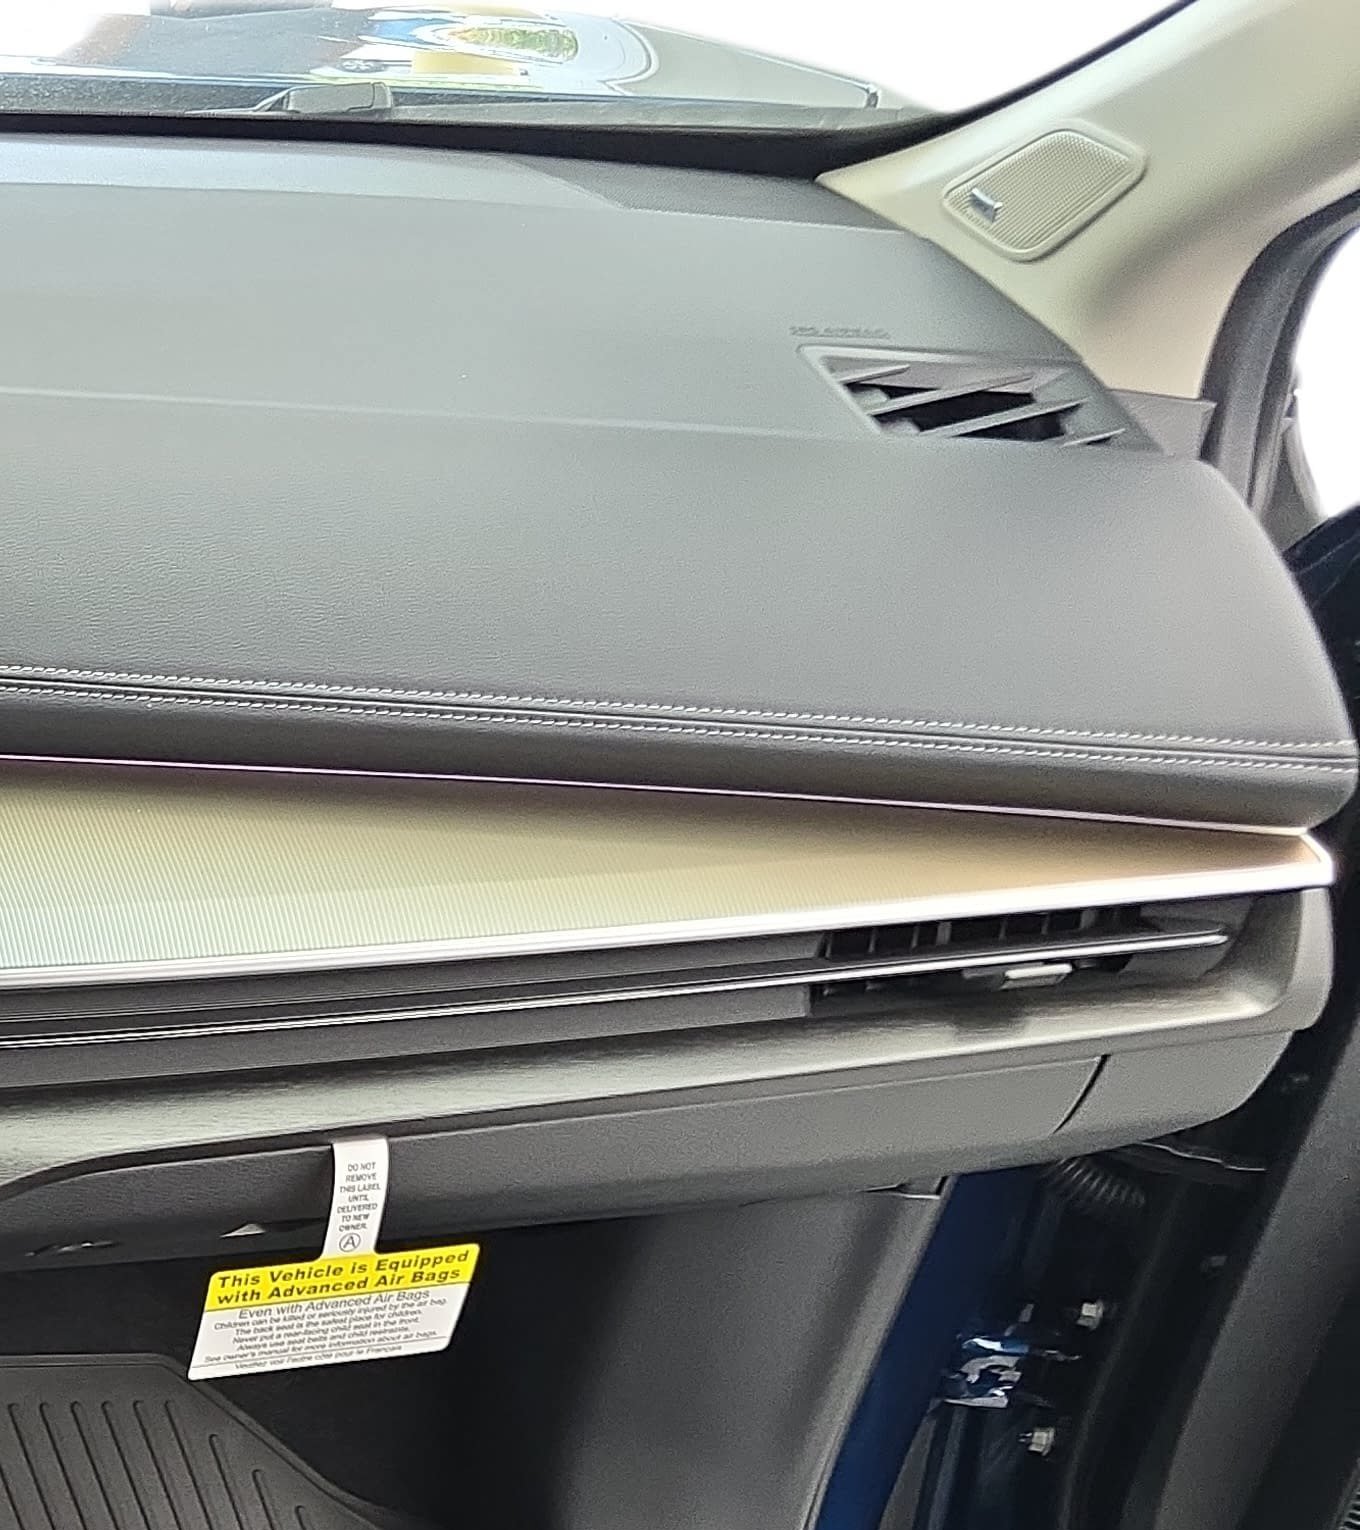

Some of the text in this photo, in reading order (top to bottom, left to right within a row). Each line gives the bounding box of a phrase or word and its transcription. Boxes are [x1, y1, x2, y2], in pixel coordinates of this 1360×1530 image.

[348, 1161, 377, 1172] DO NOT
[345, 1172, 377, 1183] REMOVE
[337, 1202, 378, 1214] DELIVERED
[341, 1214, 352, 1222] TO
[218, 1250, 469, 1289] This Vehicle is Equipped
[217, 1269, 461, 1304] with Advanced Air Bags
[214, 1321, 250, 1330] Children
[252, 1318, 268, 1326] can
[270, 1315, 281, 1323] be
[401, 1300, 415, 1308] the
[238, 1290, 431, 1320] Even with Advanced Air Bags
[232, 1336, 258, 1344] Never
[384, 1319, 397, 1327] the
[235, 1328, 252, 1336] The
[253, 1325, 273, 1334] back
[305, 1320, 320, 1328] the
